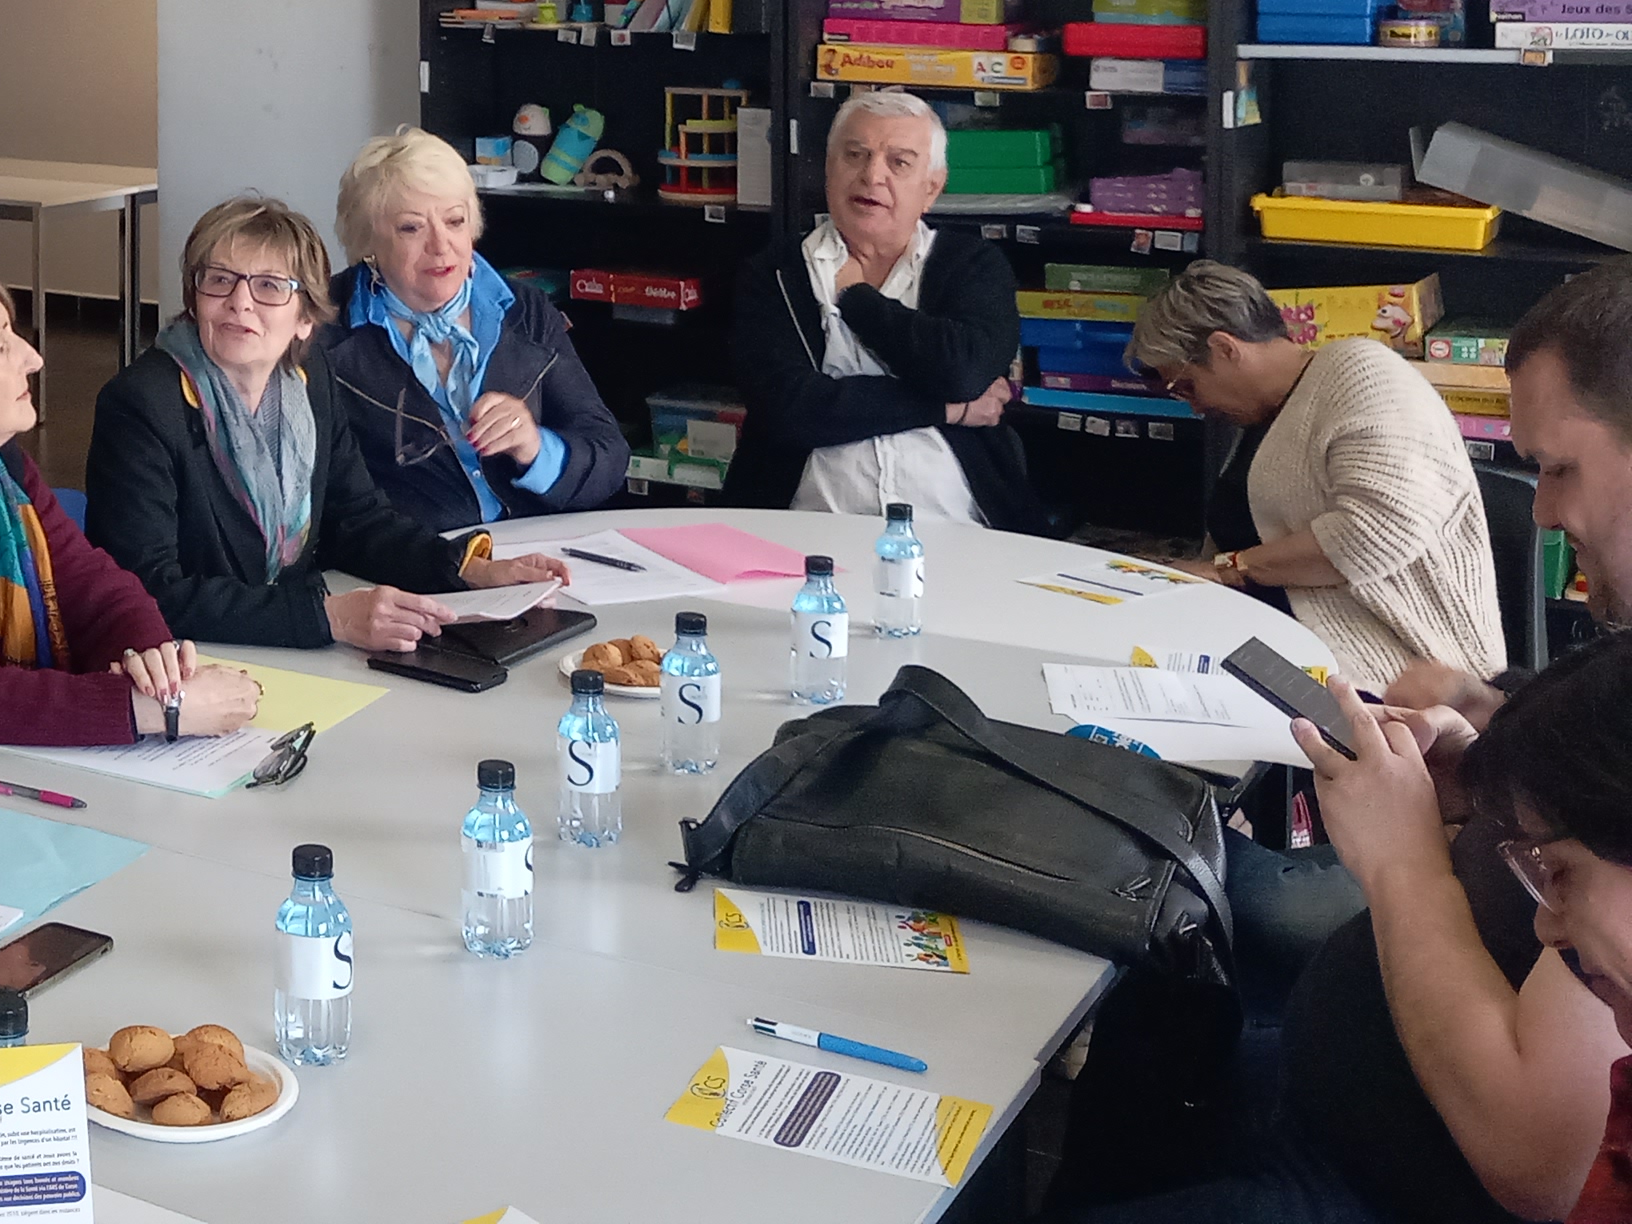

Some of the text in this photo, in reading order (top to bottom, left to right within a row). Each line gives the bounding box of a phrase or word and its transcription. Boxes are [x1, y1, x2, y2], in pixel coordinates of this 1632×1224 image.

[1561, 4, 1590, 14] Jeux
[1596, 4, 1620, 14] des
[677, 682, 704, 725] S
[567, 739, 594, 787] S
[20, 1093, 71, 1114] Santé
